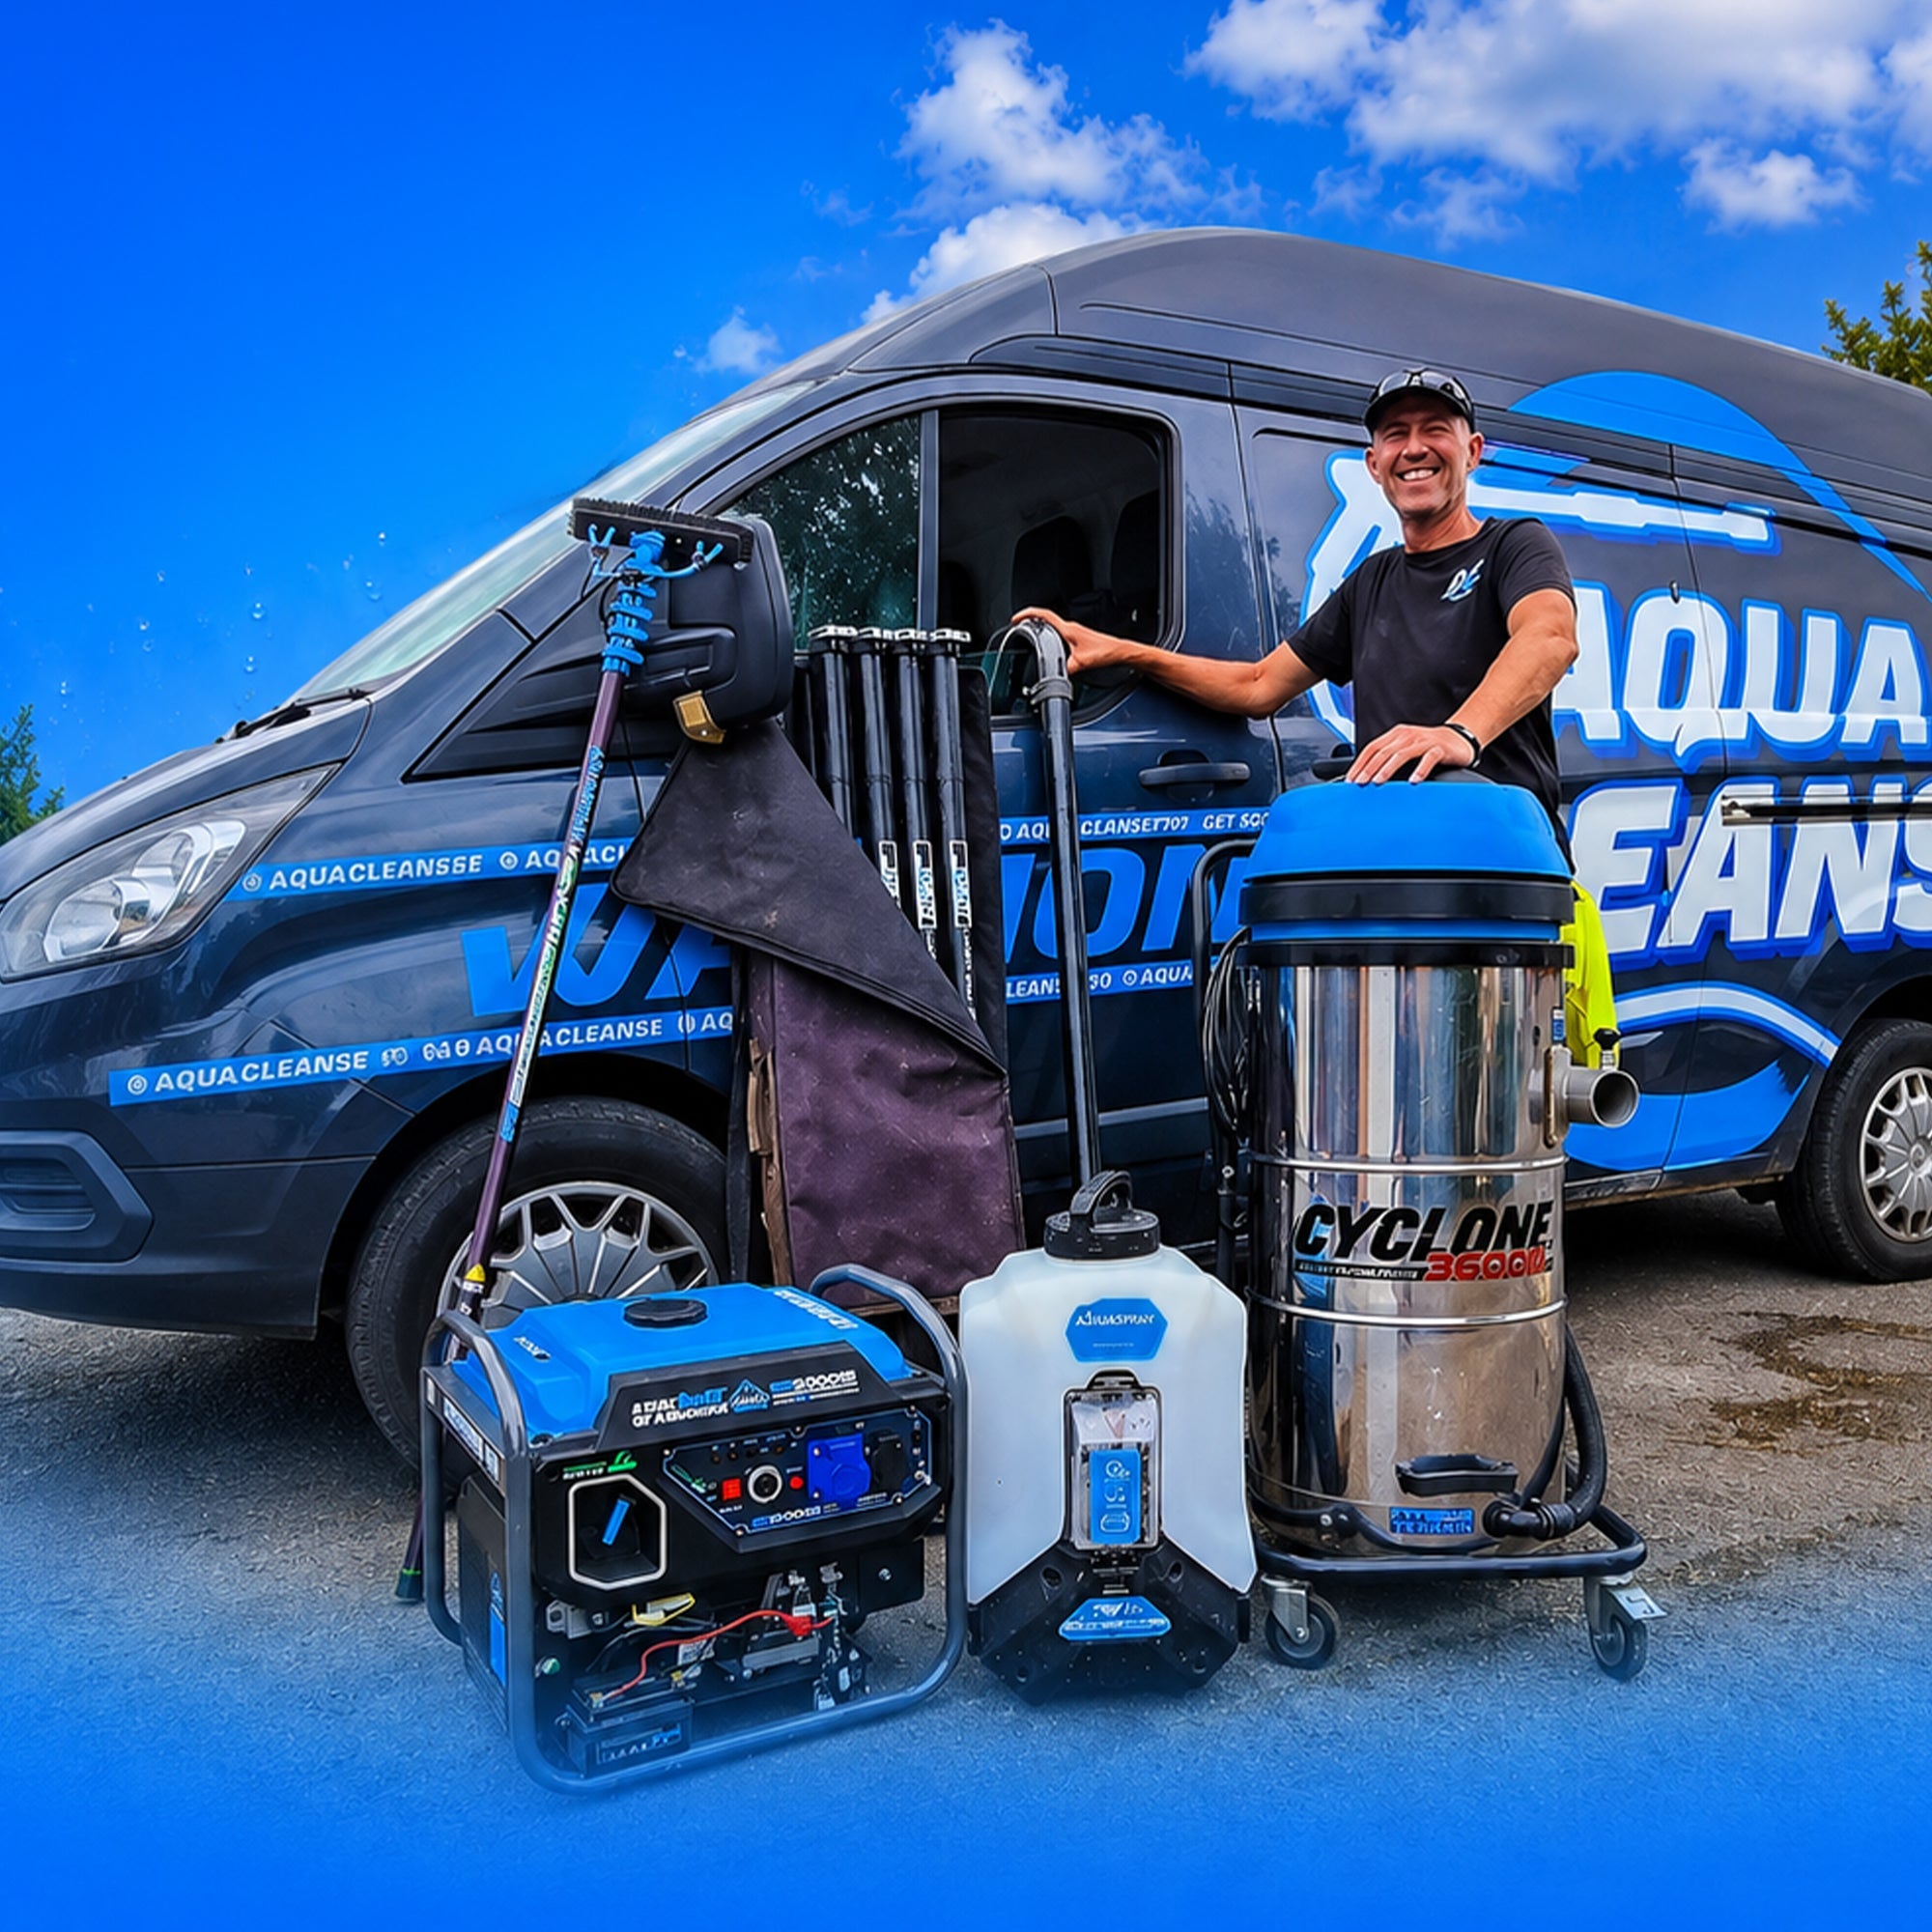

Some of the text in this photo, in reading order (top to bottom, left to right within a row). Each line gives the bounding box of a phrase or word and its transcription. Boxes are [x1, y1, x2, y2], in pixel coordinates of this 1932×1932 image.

[1551, 582, 1931, 763] AQUA
[1202, 813, 1236, 831] GET
[1294, 1201, 1554, 1263] CYCLONE
